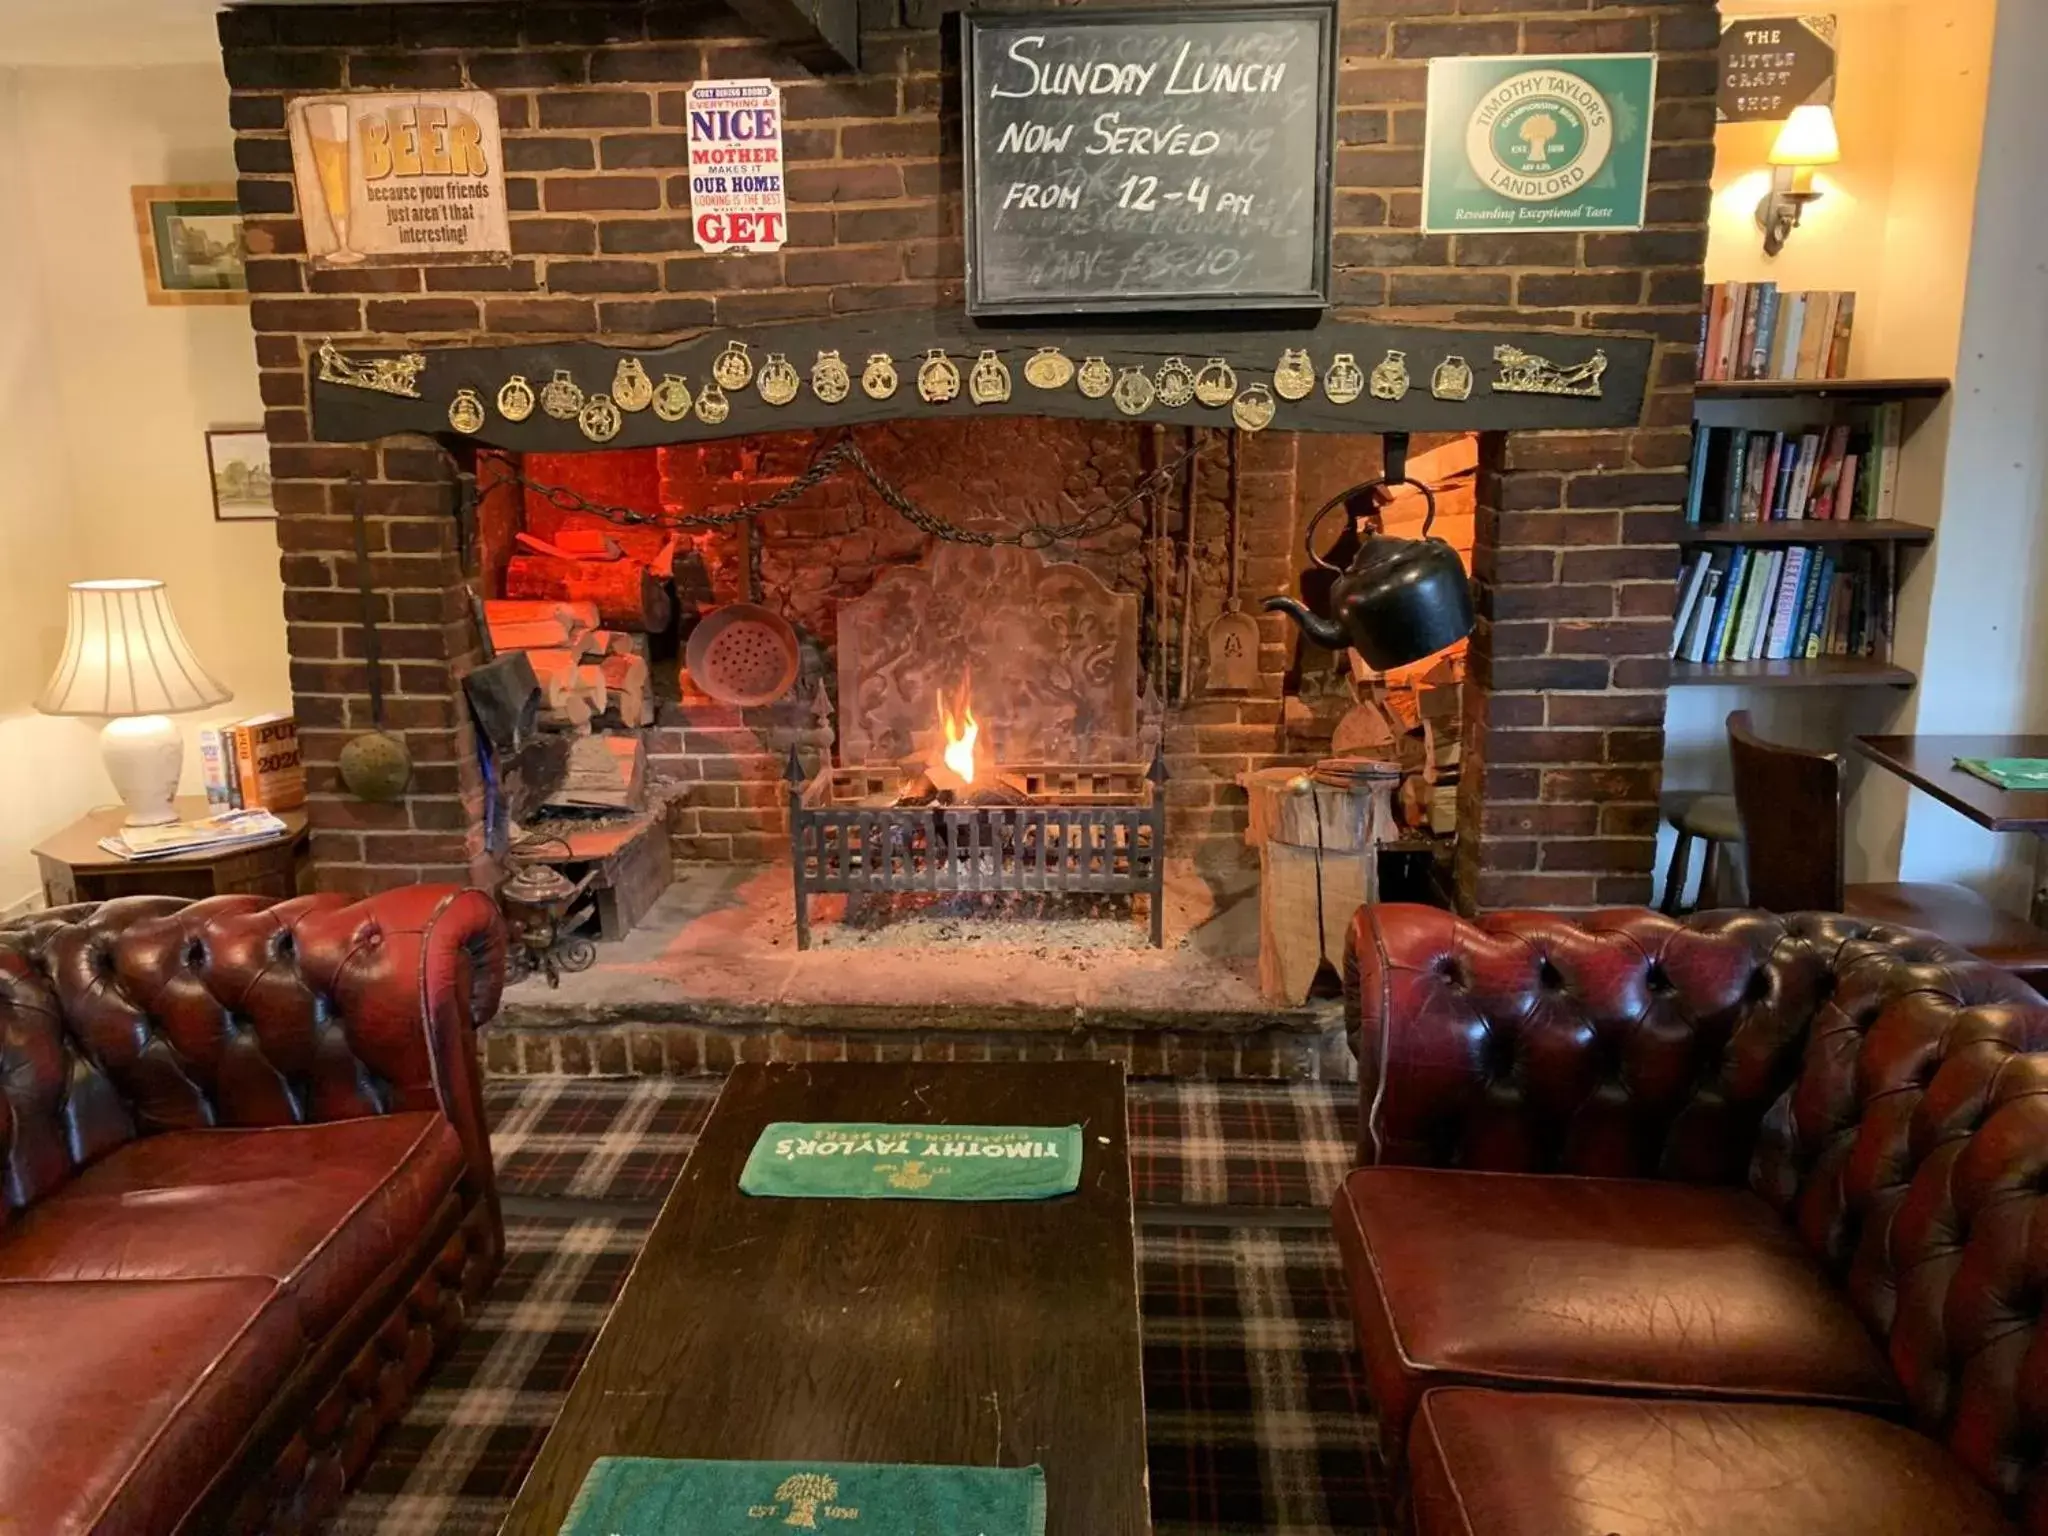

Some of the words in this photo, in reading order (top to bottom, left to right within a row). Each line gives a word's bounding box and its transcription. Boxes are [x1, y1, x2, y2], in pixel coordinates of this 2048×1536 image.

[1744, 30, 1781, 45] THE
[990, 36, 1157, 98] SUNDAY
[1164, 40, 1287, 95] LUNCH
[1728, 52, 1795, 68] LITTLE
[1726, 71, 1790, 88] CRAFT
[689, 99, 758, 110] EVERYTHING
[763, 98, 777, 107] AS
[1476, 76, 1544, 127] TIMOTHY
[1546, 76, 1606, 127] TAYLOR'S
[691, 109, 777, 141] NICE
[997, 121, 1075, 153] NOW
[1085, 111, 1220, 156] SERVED
[357, 104, 488, 180] BEER
[692, 148, 778, 164] MOTHER
[708, 165, 746, 174] MAKES
[752, 165, 762, 173] IT
[693, 177, 727, 193] OUR
[732, 175, 780, 192] HOME
[1490, 166, 1585, 197] LANDLORD
[367, 184, 417, 202] because
[419, 185, 445, 204] your
[448, 181, 489, 199] friends
[694, 194, 731, 206] COOKING
[744, 194, 758, 205] THE
[762, 193, 781, 205] BEST
[1002, 183, 1082, 210] FROM
[386, 206, 410, 226] just
[412, 204, 447, 222] aren't
[449, 203, 475, 220] that
[1455, 207, 1515, 223] Rewarding
[1518, 204, 1582, 222] Exceptional
[1585, 205, 1613, 218] Taste
[399, 225, 468, 245] interesting!
[697, 213, 783, 244] GET
[776, 1138, 910, 1160] TAYLOR'S
[919, 1141, 1059, 1159] TIMOTHY
